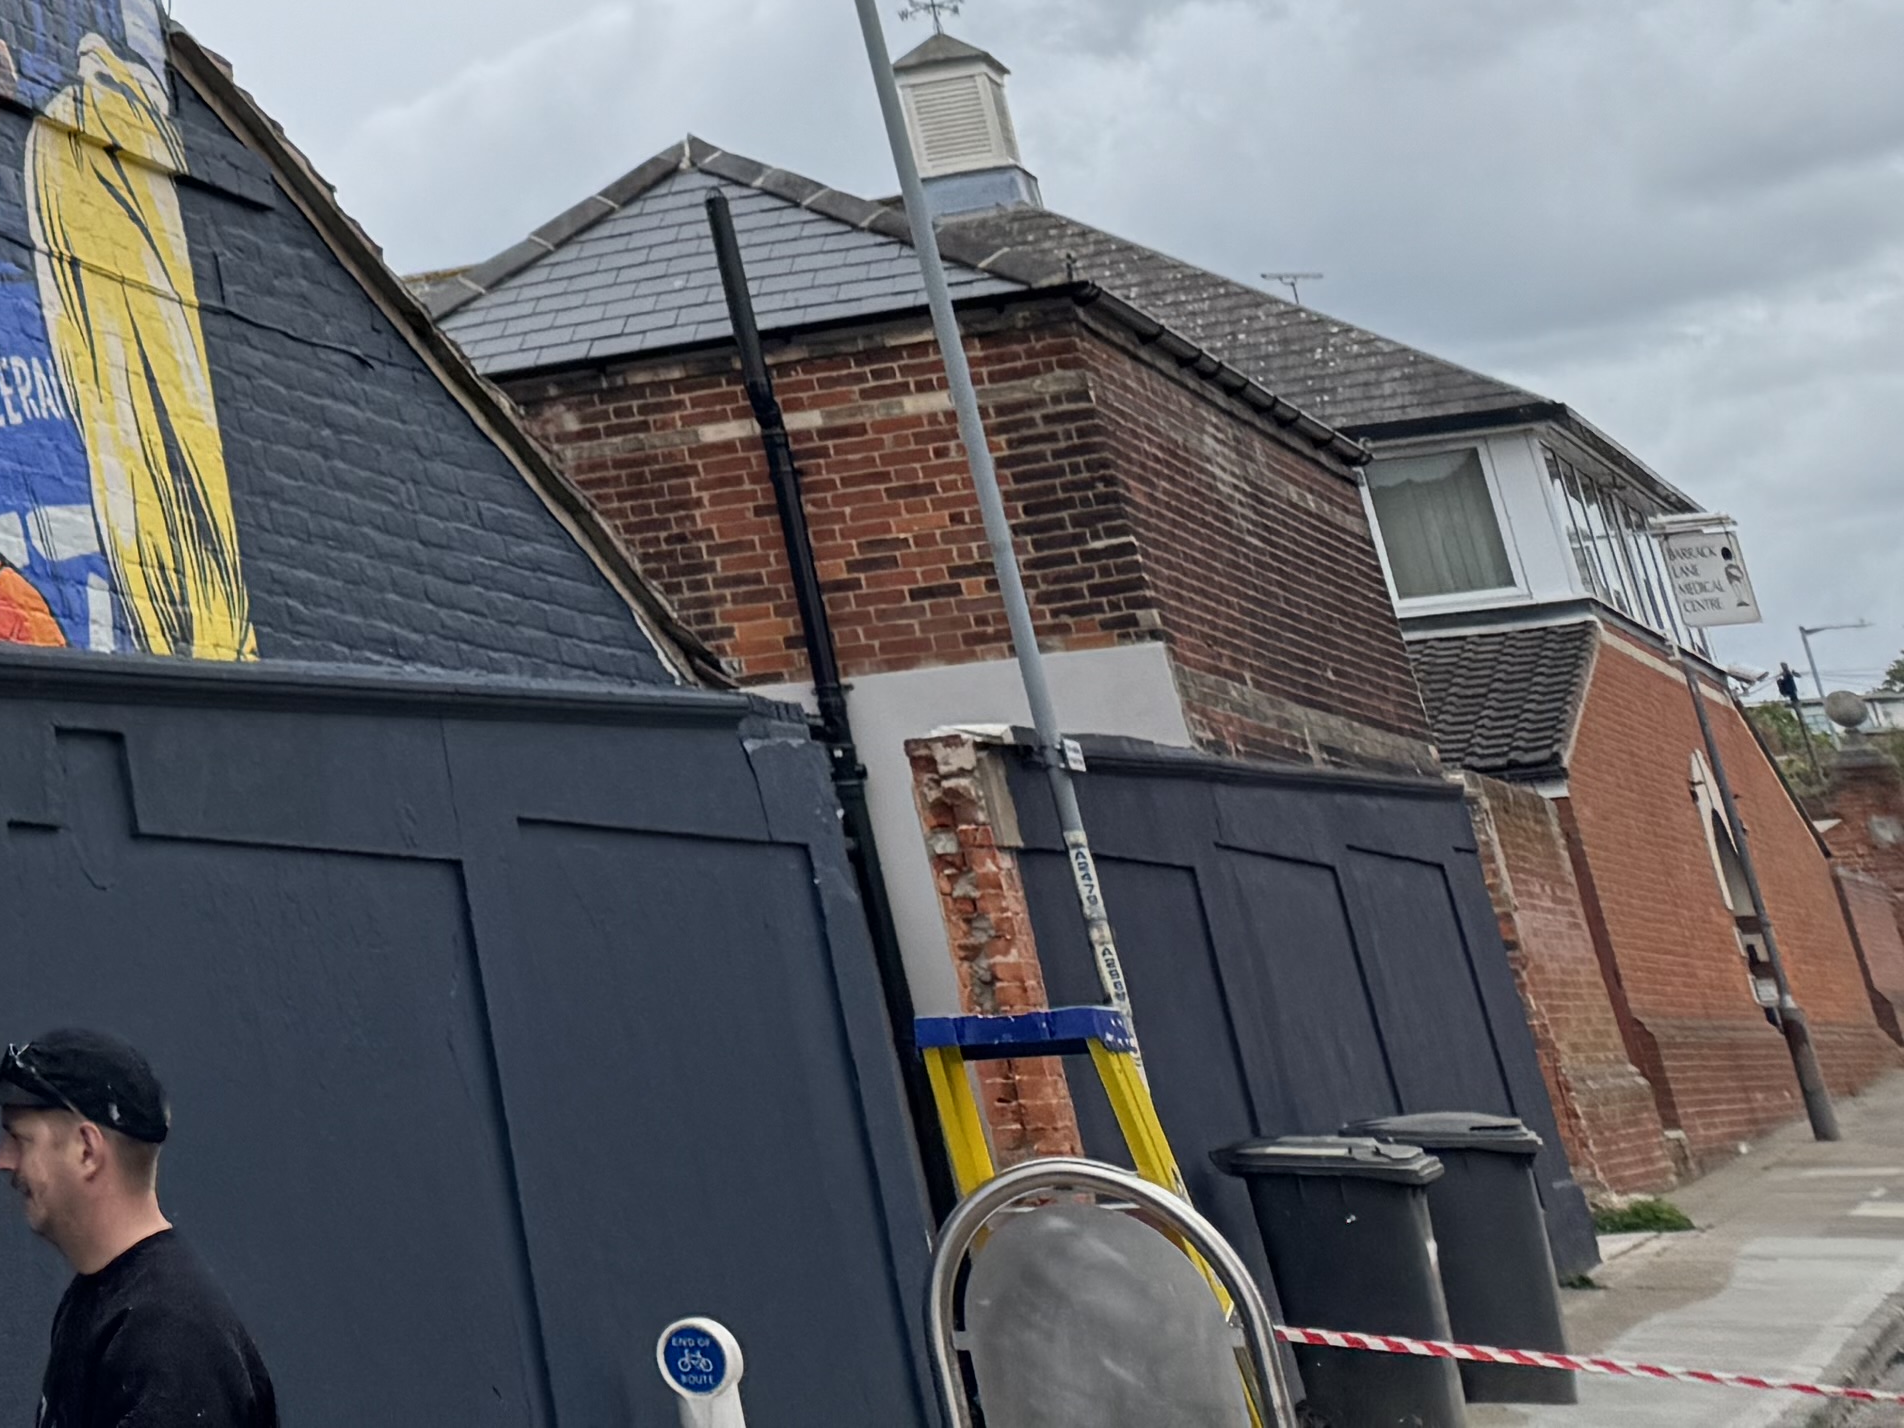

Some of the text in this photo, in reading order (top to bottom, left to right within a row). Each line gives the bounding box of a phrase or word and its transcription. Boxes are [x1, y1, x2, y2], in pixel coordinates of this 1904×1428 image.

[1666, 546, 1718, 561] BARRACK
[1672, 565, 1701, 579] LANE
[1678, 579, 1726, 596] MEDICAL
[1683, 598, 1725, 614] CENTRE
[672, 1337, 710, 1347] END OF
[680, 1374, 716, 1385] ROUTE
